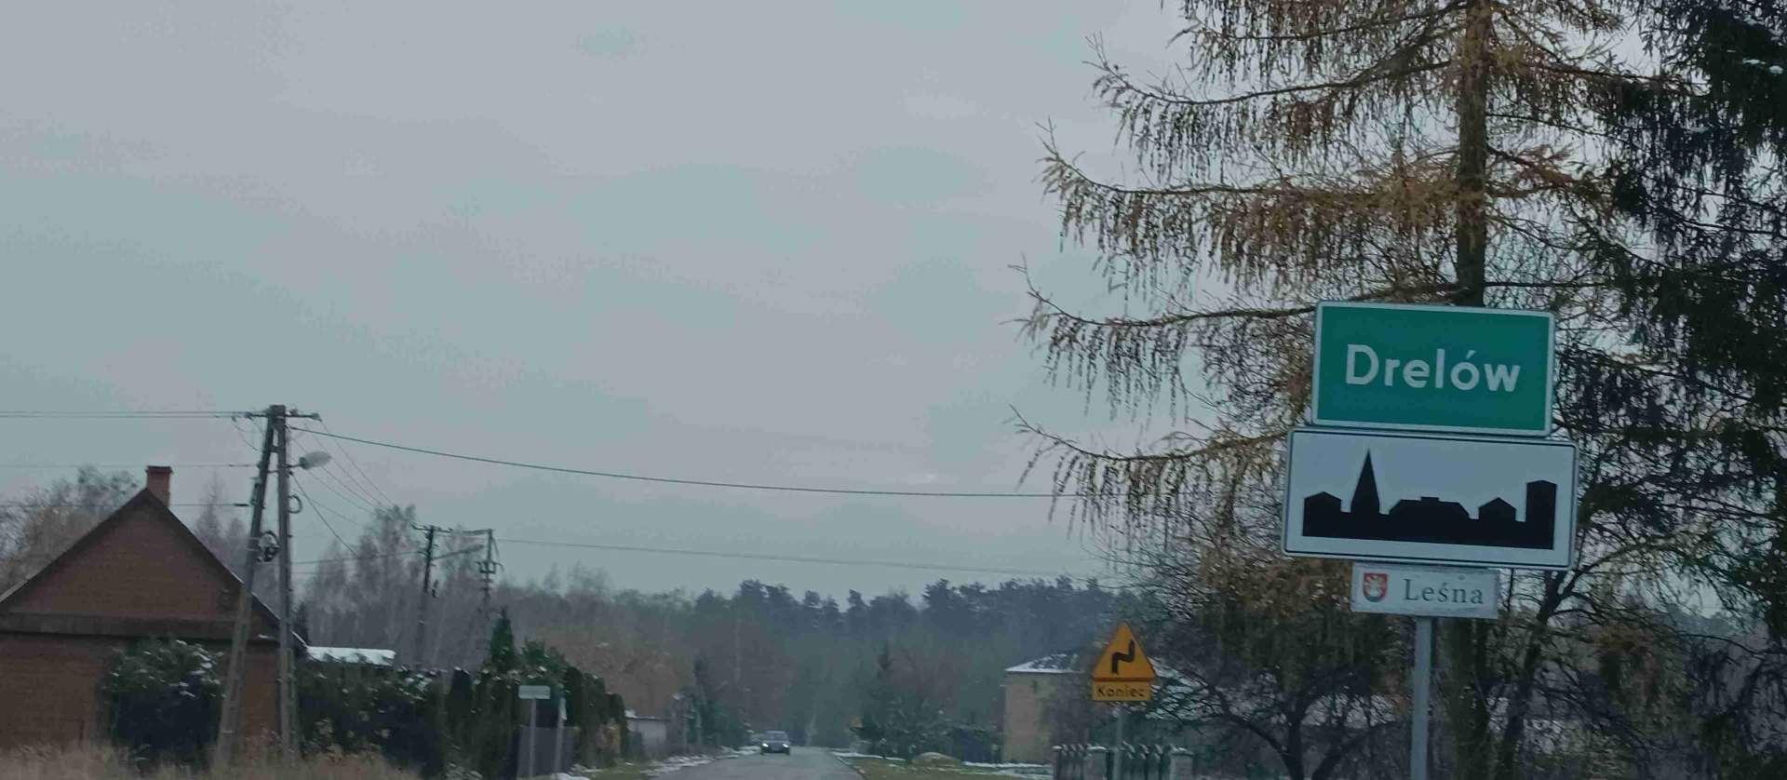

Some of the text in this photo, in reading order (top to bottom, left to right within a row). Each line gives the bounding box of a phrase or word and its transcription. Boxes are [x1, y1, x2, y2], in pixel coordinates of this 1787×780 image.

[1345, 344, 1521, 392] Drelów
[1402, 578, 1484, 604] Leśna
[1096, 684, 1146, 698] Koniec
